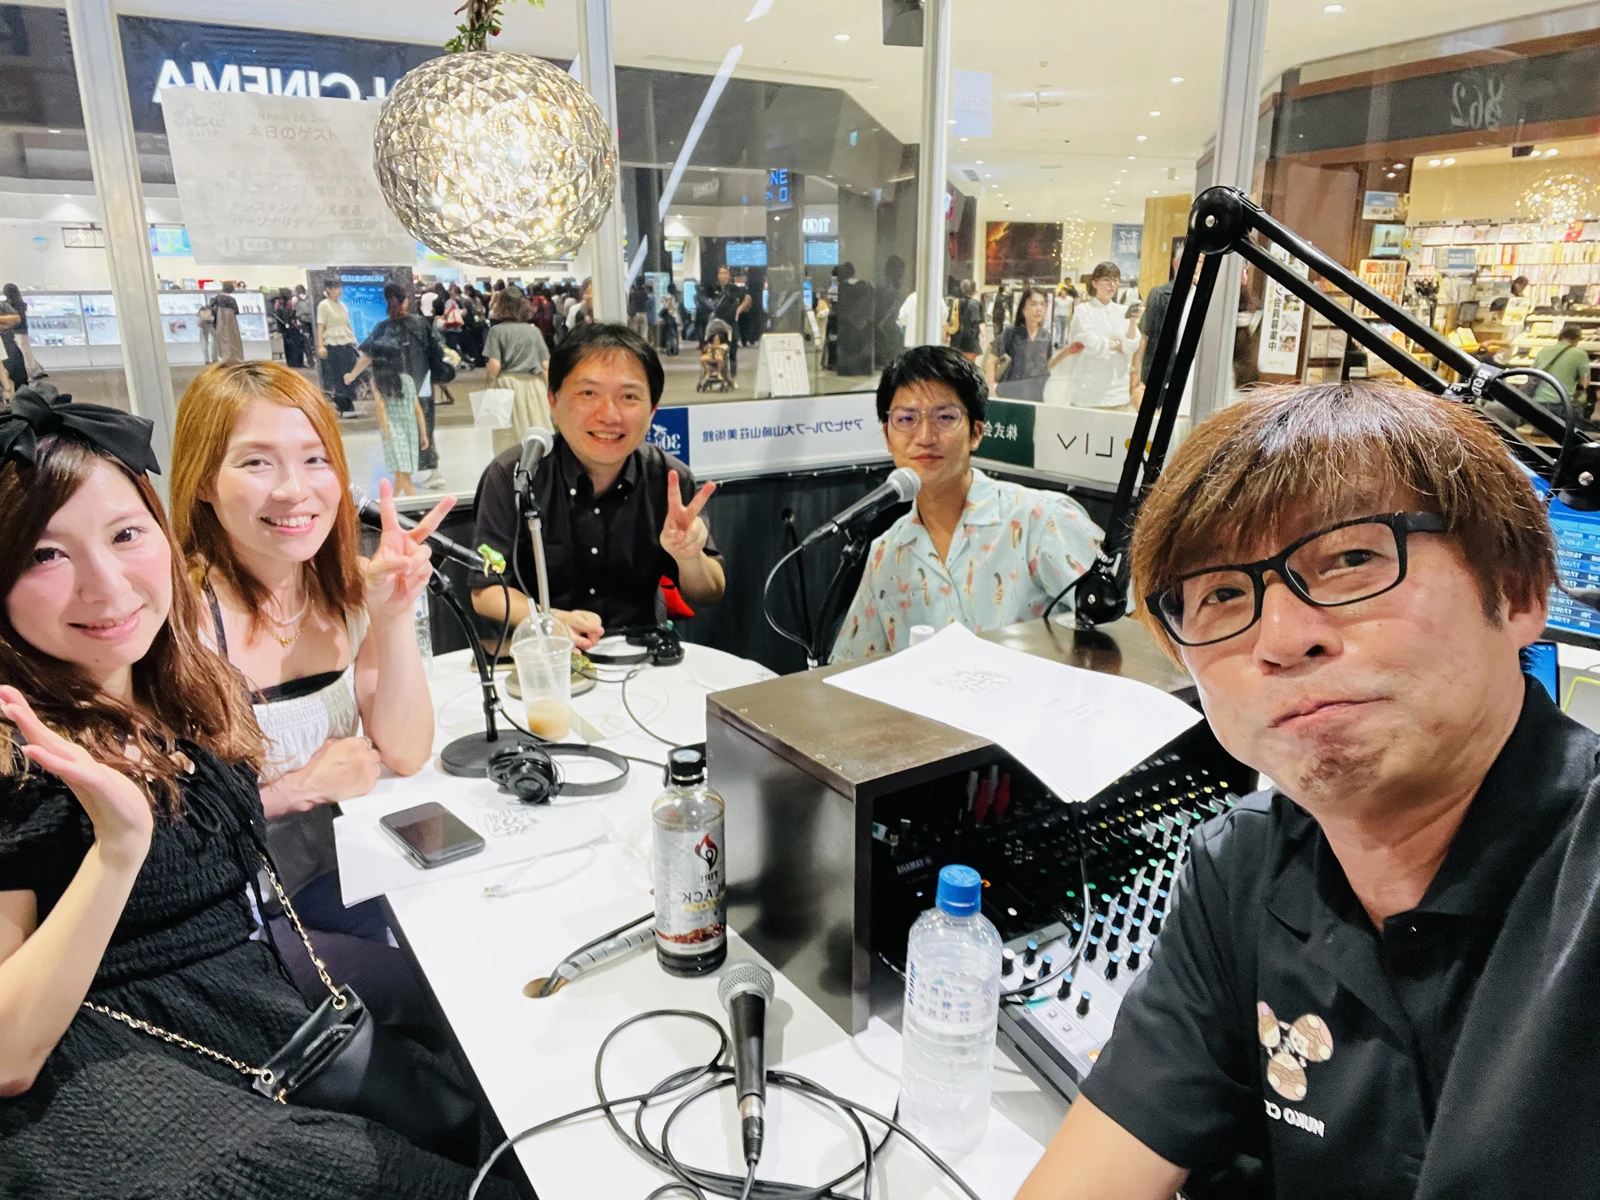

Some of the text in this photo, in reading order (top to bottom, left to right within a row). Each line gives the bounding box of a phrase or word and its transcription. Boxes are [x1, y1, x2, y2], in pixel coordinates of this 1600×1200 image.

[246, 123, 339, 142] 本日のゲスト
